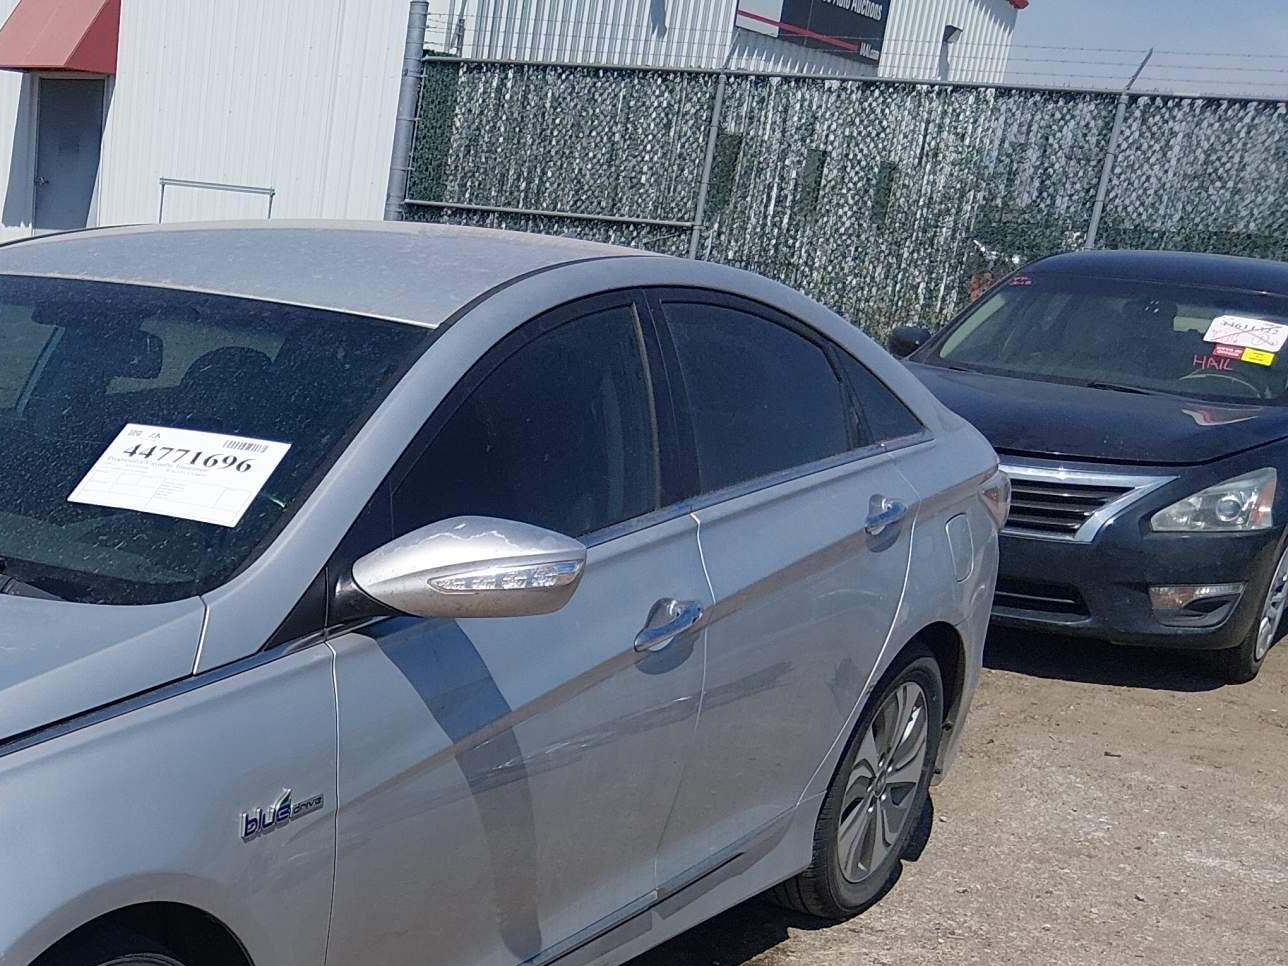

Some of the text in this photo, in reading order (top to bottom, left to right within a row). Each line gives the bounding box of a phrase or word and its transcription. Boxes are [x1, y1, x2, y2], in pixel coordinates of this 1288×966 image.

[1192, 354, 1233, 371] HAIL
[123, 443, 257, 473] 44771696
[240, 792, 292, 838] blue
